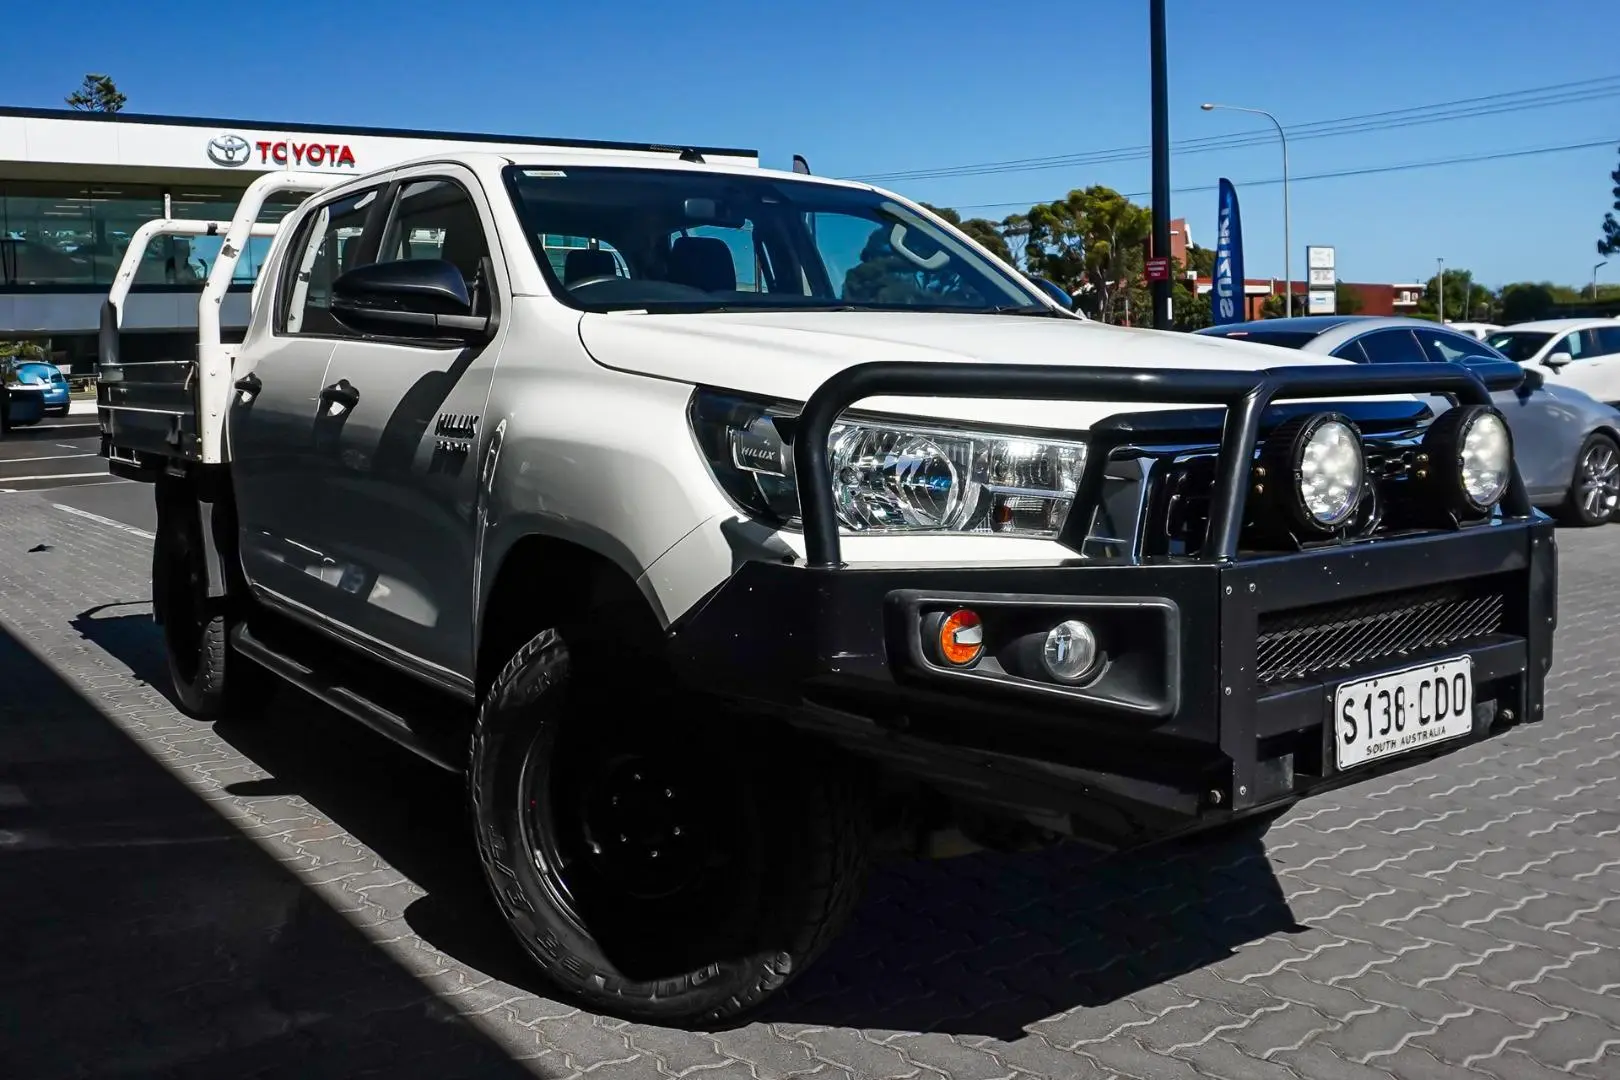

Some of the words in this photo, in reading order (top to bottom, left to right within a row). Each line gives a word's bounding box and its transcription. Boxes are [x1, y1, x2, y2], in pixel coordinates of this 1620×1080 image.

[256, 142, 355, 168] TOYOTA
[742, 447, 776, 460] HILUX
[1366, 738, 1397, 756] SOUTH
[1400, 726, 1446, 746] AUSTRALIA
